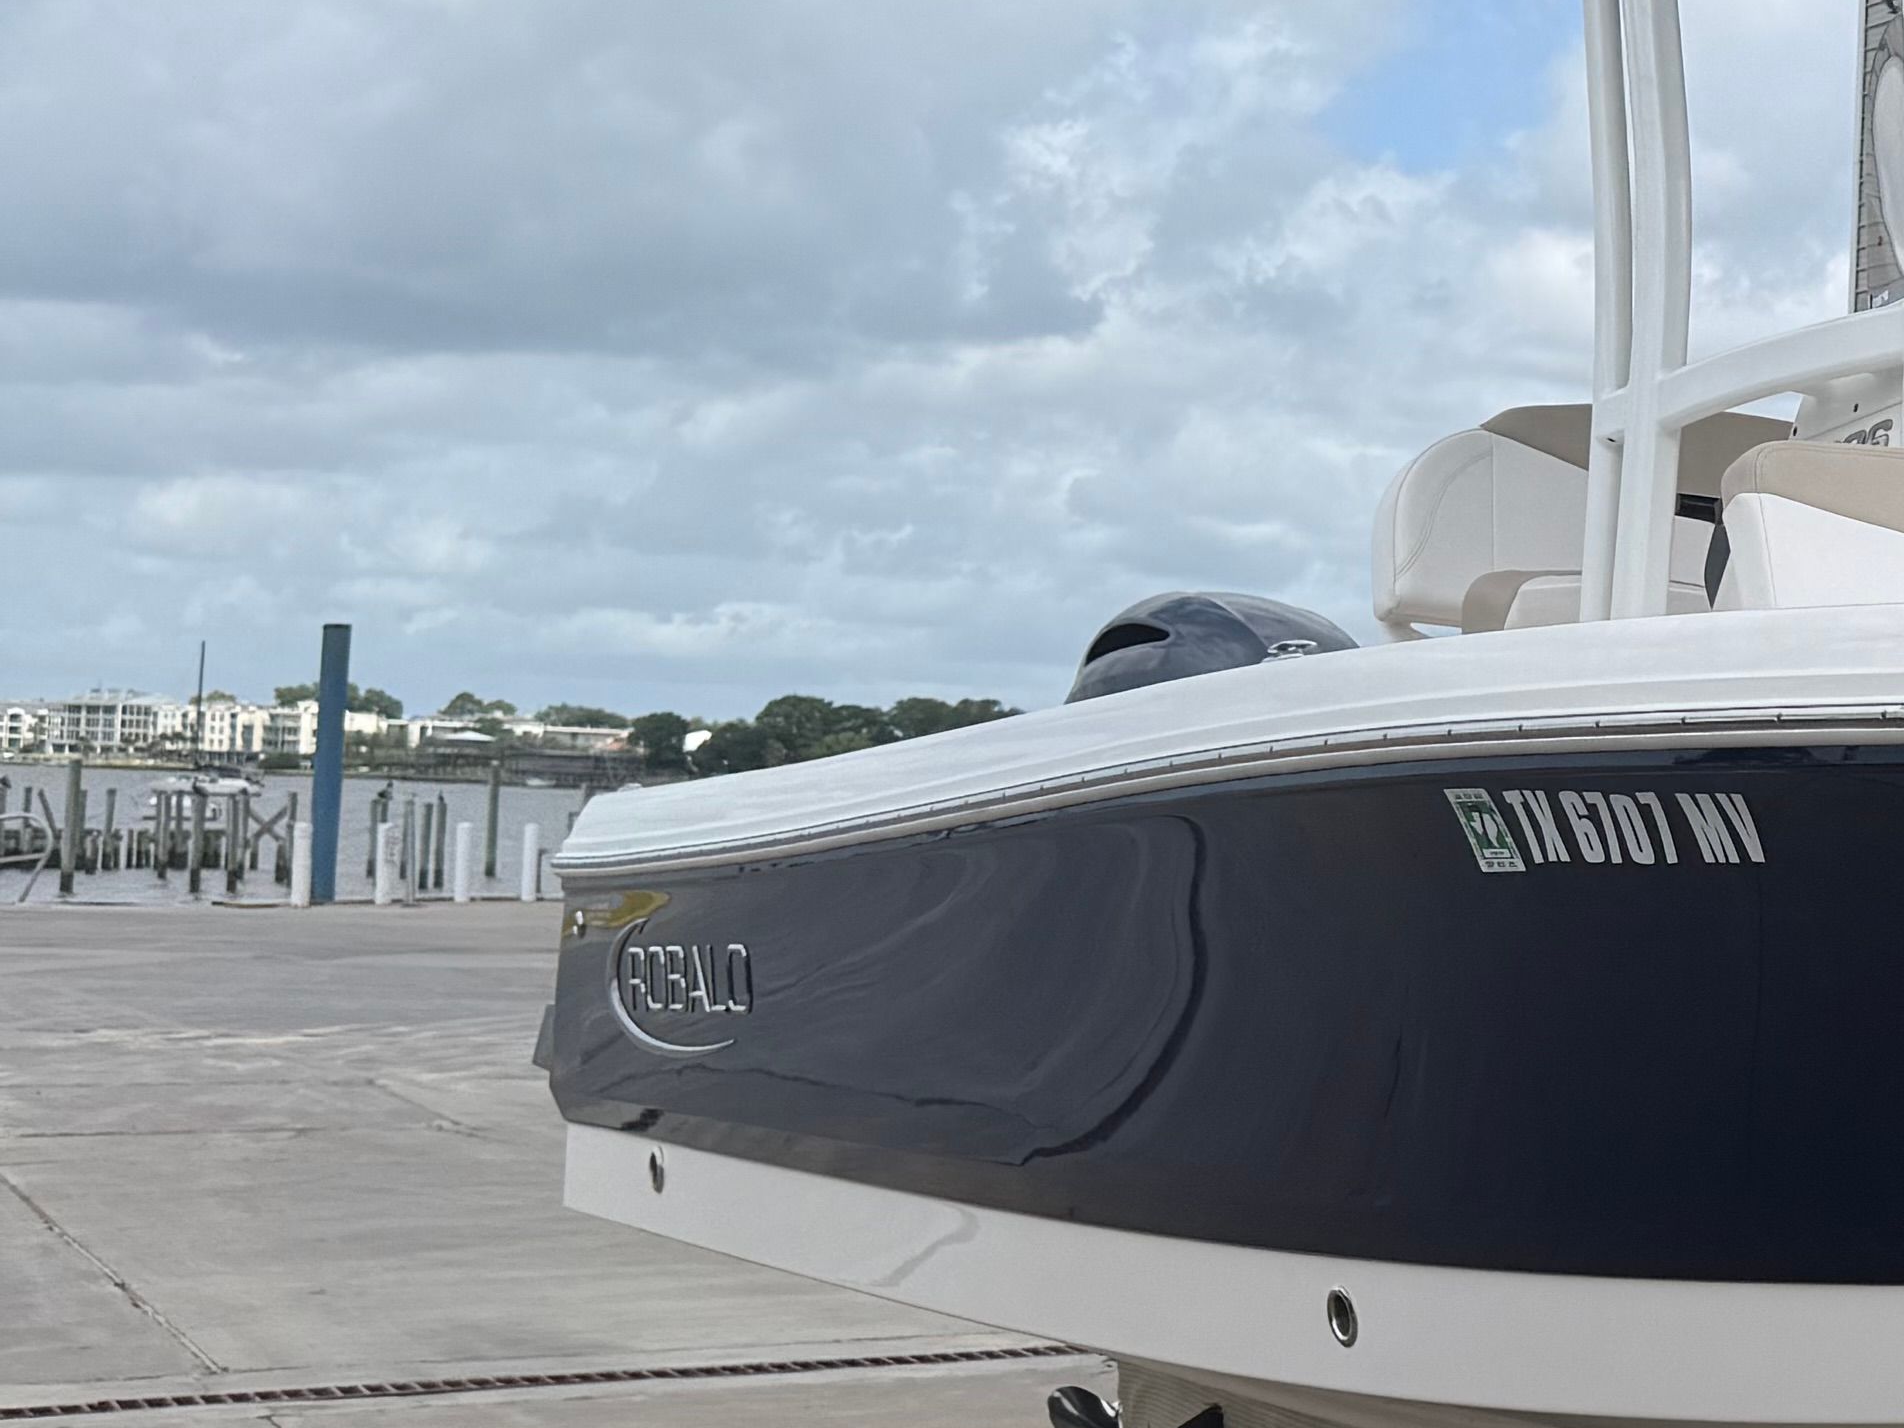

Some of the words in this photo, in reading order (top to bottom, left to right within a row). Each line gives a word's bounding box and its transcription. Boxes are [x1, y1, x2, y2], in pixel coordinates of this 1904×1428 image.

[1502, 789, 1572, 864] TX
[1558, 790, 1679, 865] 6707
[1674, 792, 1766, 864] MV
[627, 943, 753, 1014] ROBALO
